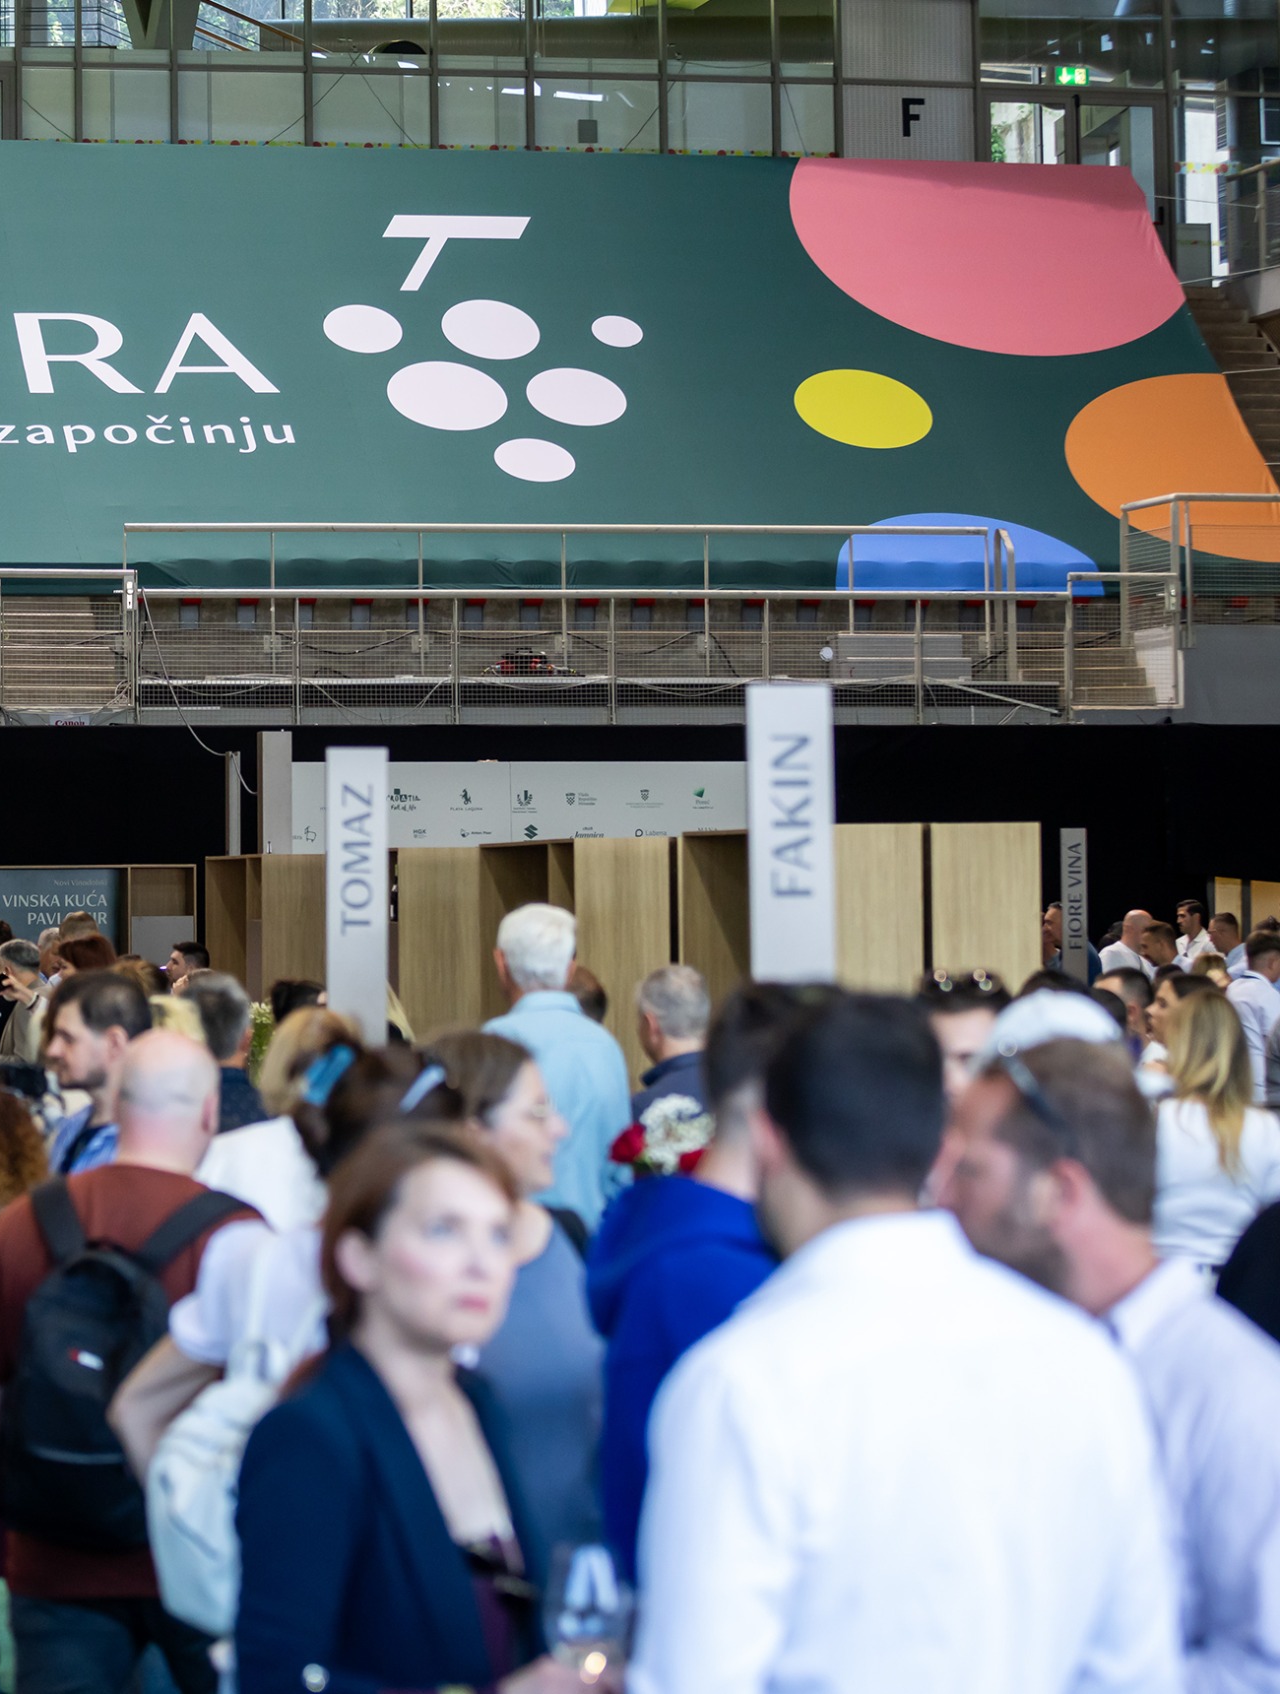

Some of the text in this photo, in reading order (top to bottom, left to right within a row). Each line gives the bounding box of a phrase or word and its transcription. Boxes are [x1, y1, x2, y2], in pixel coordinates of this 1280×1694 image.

[901, 97, 925, 137] F
[340, 784, 373, 936] TOMAZ
[770, 734, 812, 897] FAKIN
[2, 890, 108, 907] VINSKA KUĆA
[1067, 843, 1083, 950] FIORE VINA
